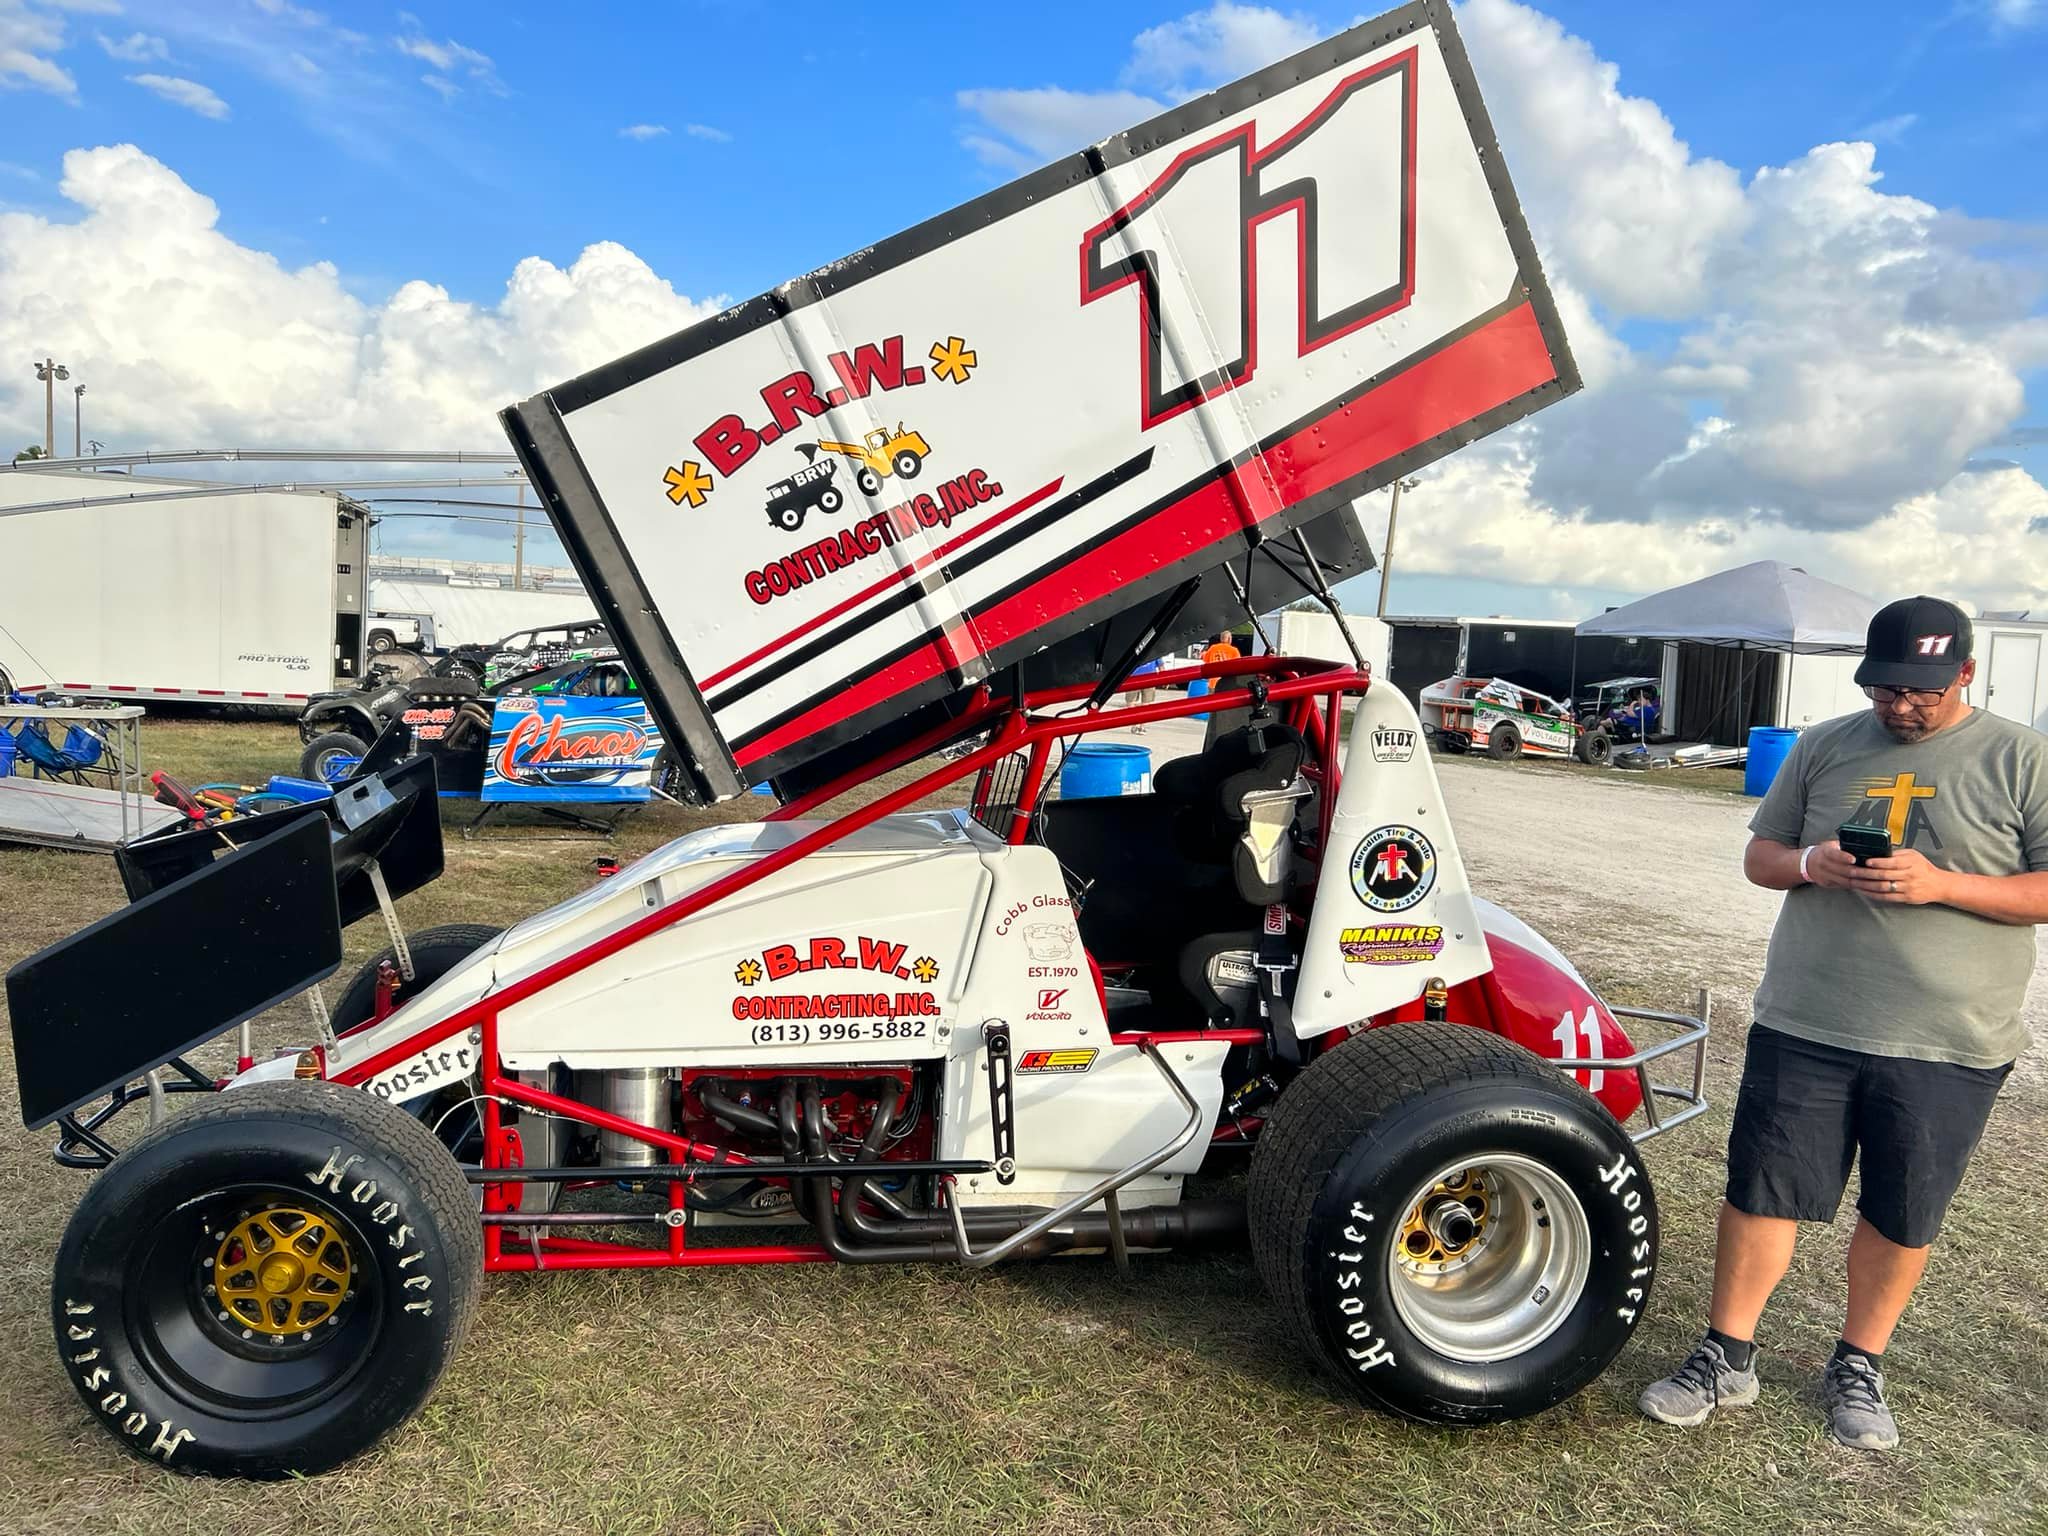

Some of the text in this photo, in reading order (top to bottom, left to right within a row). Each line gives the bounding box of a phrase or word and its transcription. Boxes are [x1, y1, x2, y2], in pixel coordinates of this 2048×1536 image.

[1069, 45, 1418, 432] 11
[693, 335, 926, 478] B.R.W.
[794, 460, 832, 487] BRW
[266, 656, 310, 664] STOCK
[1915, 634, 1952, 656] 11
[502, 713, 646, 779] Chaos
[1374, 731, 1413, 747] VELOX
[1353, 829, 1431, 869] Meredith Tire & Auto
[996, 894, 1071, 936] Cobb Glass
[1339, 926, 1442, 943] MANIKIS
[762, 936, 911, 982] B.R.W.
[1028, 967, 1078, 977] EST.1970
[751, 1021, 926, 1045] (813) 996-5882
[1552, 1005, 1604, 1093] 11
[305, 1145, 434, 1317] Hoosier
[1600, 1153, 1653, 1325] Hoosier
[1328, 1200, 1396, 1373] Hoosier
[65, 1298, 197, 1462] Hoosier
